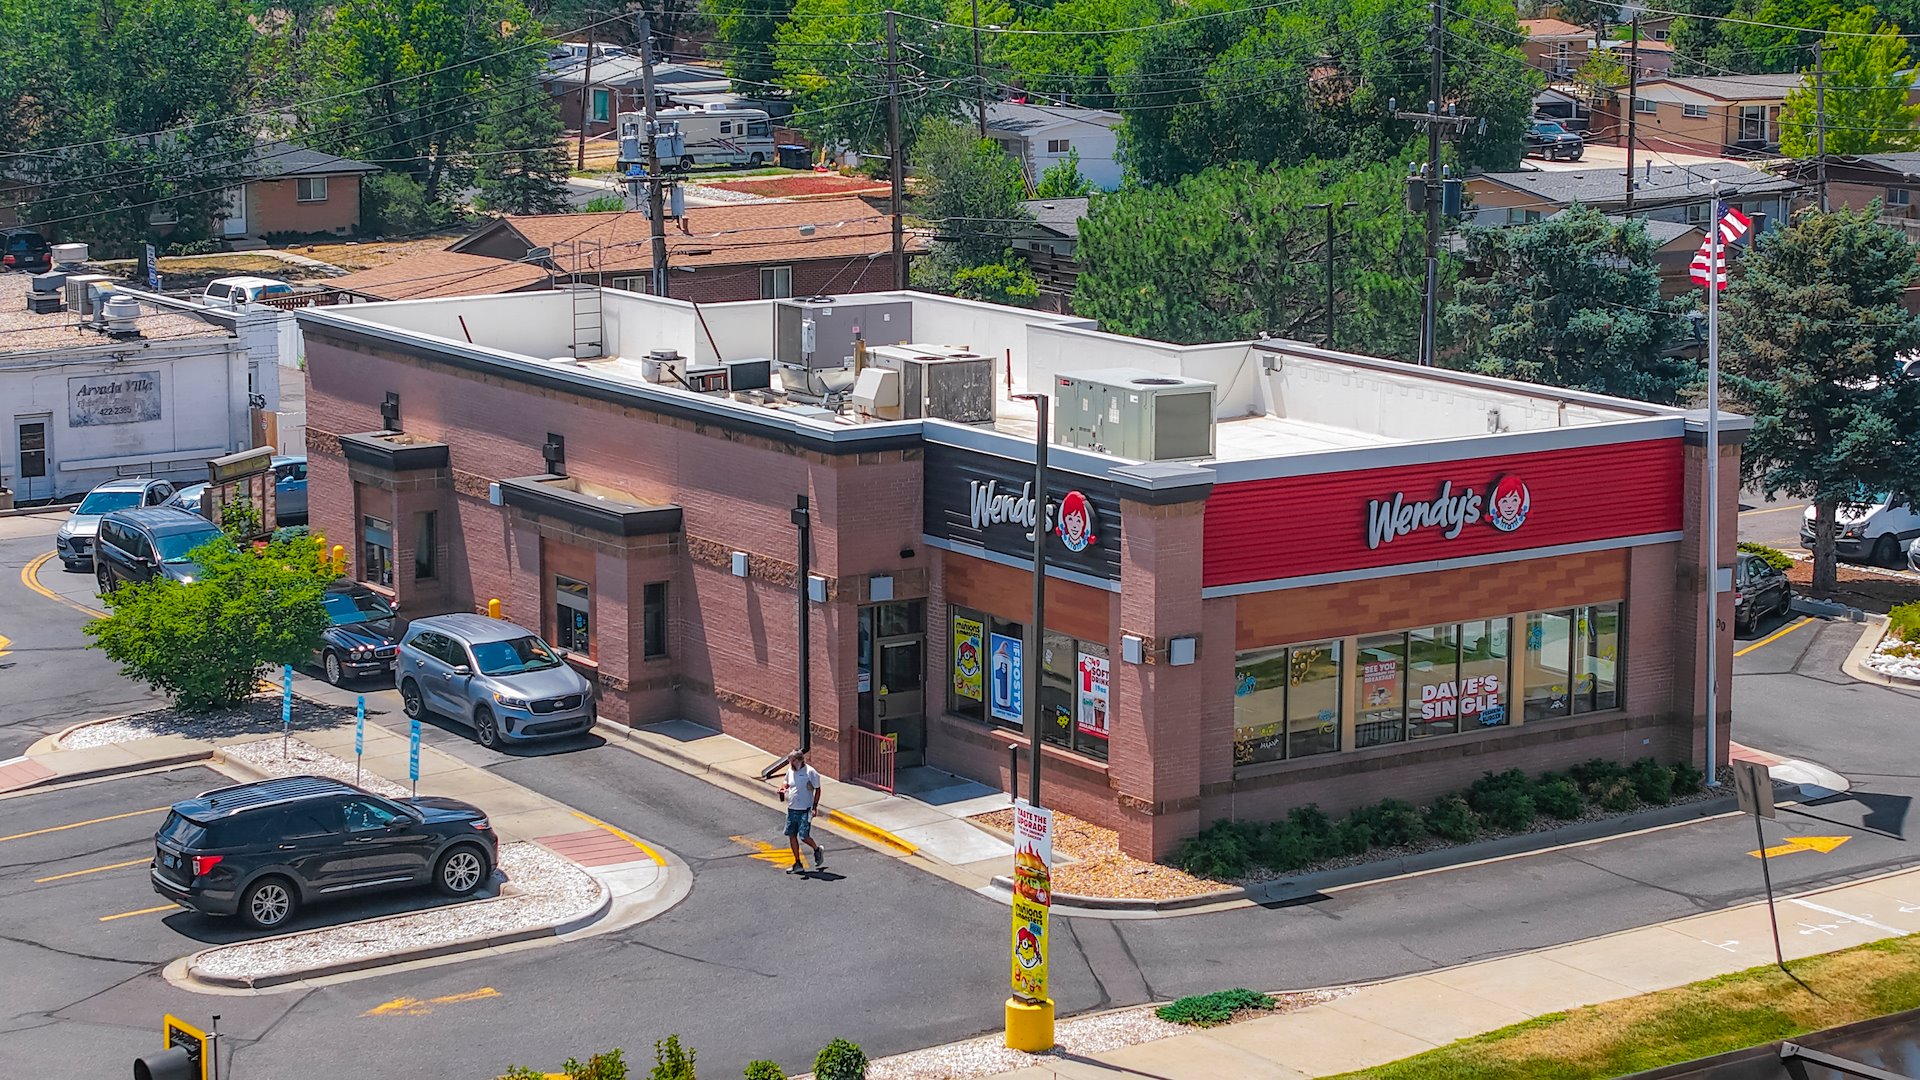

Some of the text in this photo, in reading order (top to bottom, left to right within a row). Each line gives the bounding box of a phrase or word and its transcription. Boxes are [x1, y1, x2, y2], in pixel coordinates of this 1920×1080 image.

[76, 382, 122, 396] Arvada
[1368, 480, 1482, 549] Wendy's
[1091, 667, 1110, 679] SOFT
[1364, 662, 1395, 674] SEE YOU
[1013, 648, 1021, 713] FROSTY
[1422, 675, 1498, 701] DAVE'S
[1421, 694, 1498, 720] SINGLE
[1017, 808, 1047, 824] TASTE THE
[1017, 818, 1047, 833] UPGRADE
